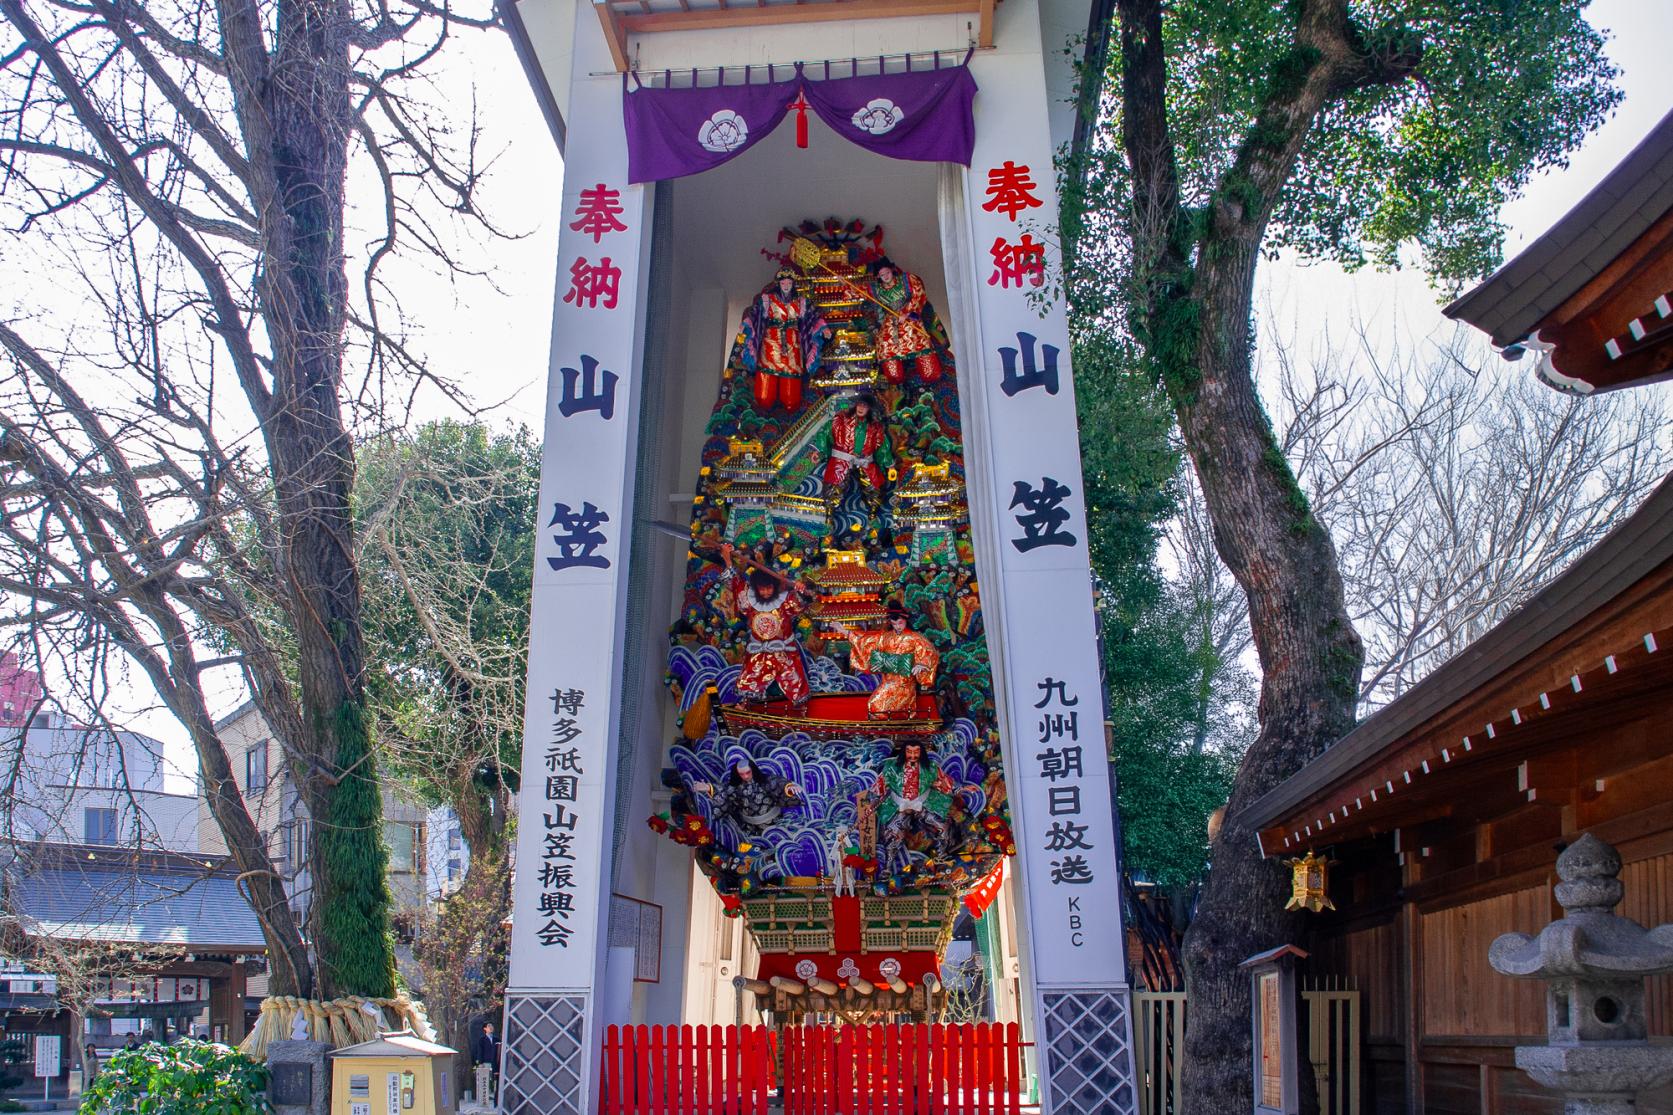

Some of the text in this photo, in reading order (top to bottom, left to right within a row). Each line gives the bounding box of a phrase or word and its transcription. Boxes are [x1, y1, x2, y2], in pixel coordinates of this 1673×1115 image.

[565, 183, 628, 310] 奉納
[981, 160, 1044, 289] 奉納
[546, 354, 619, 572] 山笠
[997, 331, 1077, 554] 山笠
[535, 688, 585, 948] 博多祇園山笠振興会
[1033, 677, 1094, 885] 九州朝日放送
[1068, 896, 1084, 947] KBC
